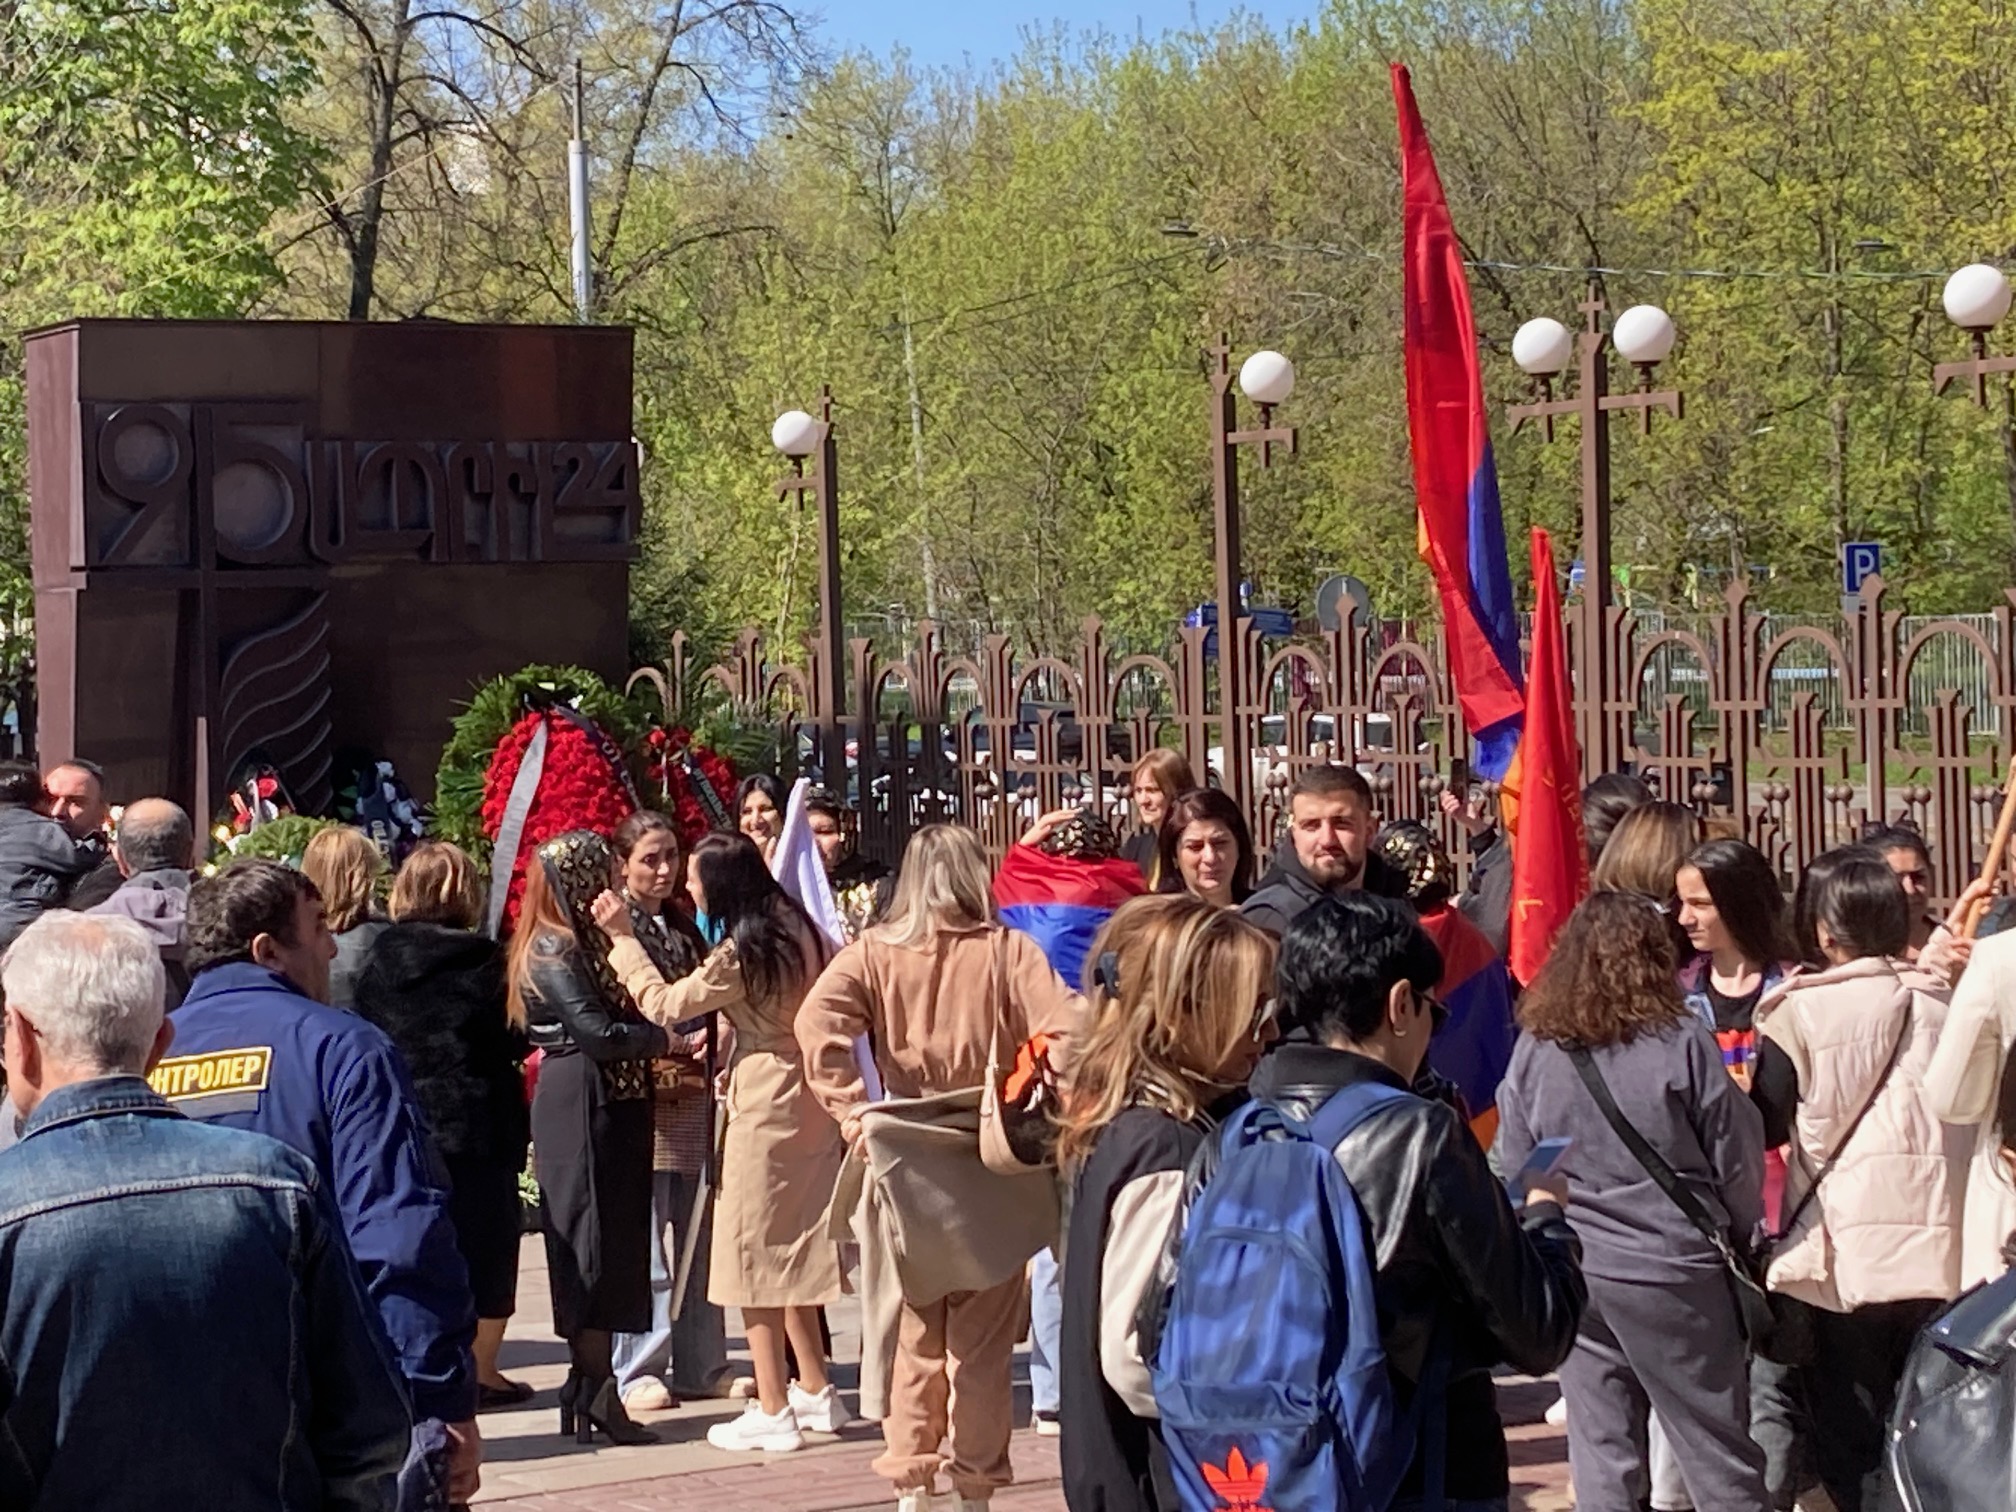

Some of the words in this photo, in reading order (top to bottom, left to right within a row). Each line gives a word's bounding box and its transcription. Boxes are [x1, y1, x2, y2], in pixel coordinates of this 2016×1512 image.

[552, 441, 640, 507] 24
[1855, 549, 1875, 588] P
[147, 1056, 261, 1095] НТРОЛЕР
